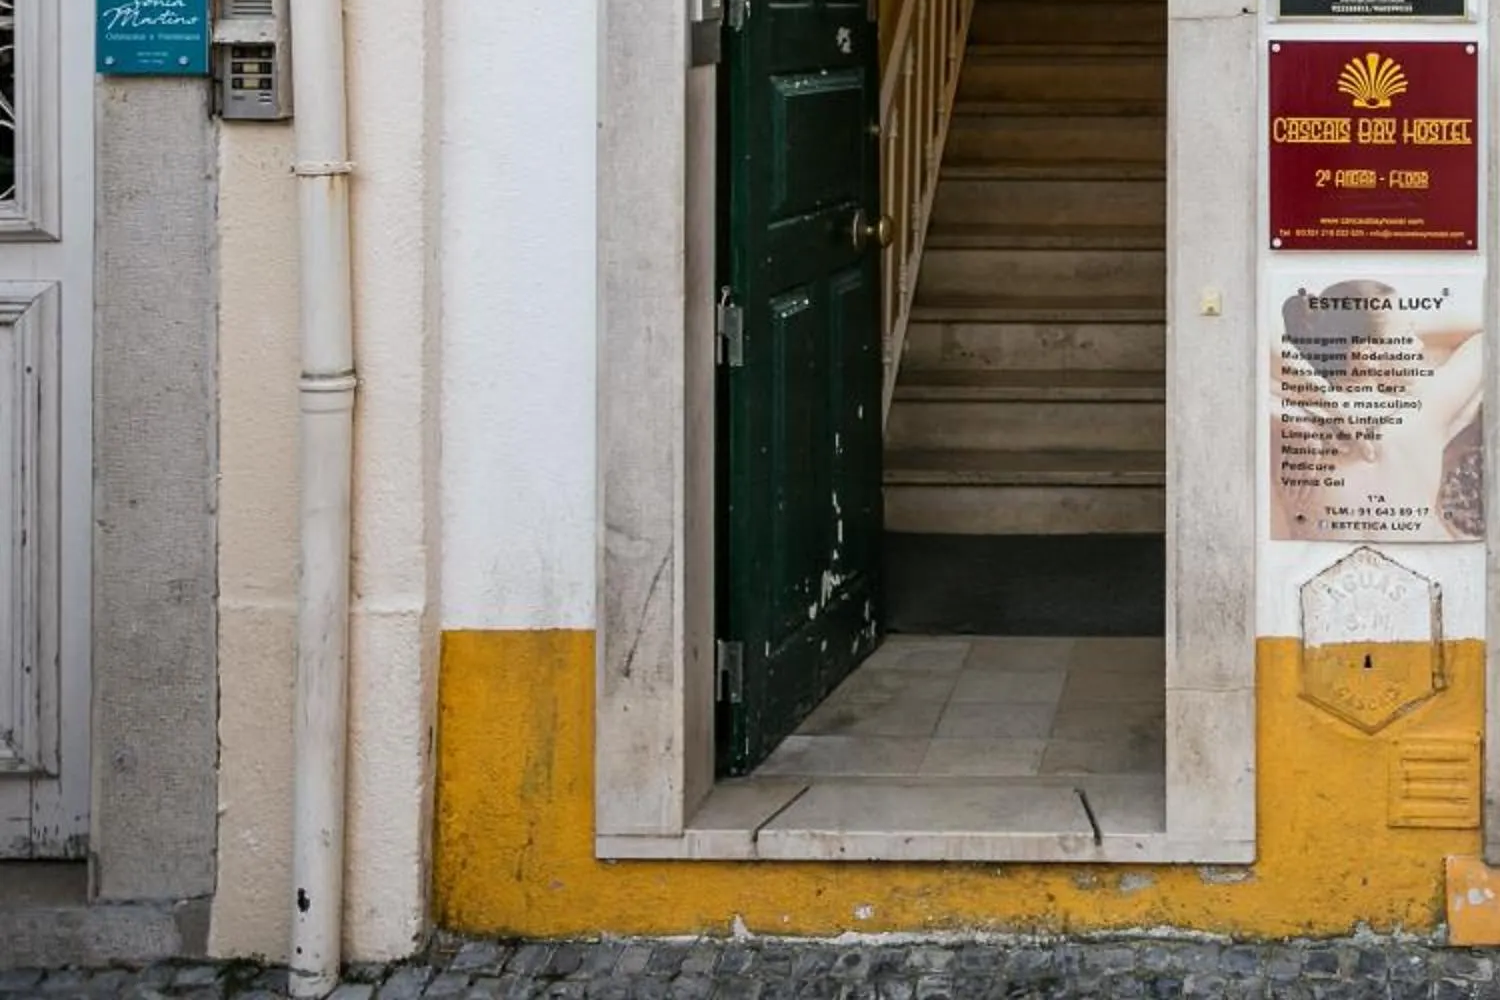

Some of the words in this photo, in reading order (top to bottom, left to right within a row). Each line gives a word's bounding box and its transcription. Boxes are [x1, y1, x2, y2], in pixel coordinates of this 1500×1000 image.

[1357, 117, 1397, 144] BAY
[1403, 118, 1473, 145] HOSTEL
[1399, 298, 1445, 310] LUCY
[1281, 336, 1347, 347] Massagem
[1351, 336, 1414, 345] Relaxante
[1281, 351, 1347, 362] Massagem
[1351, 351, 1424, 361] Modeladora
[1281, 367, 1347, 378] Massagem
[1347, 384, 1373, 393] com
[1377, 383, 1406, 392] Cera
[1353, 399, 1423, 411] masculino)
[1281, 446, 1339, 455] Manicure
[1281, 462, 1336, 471] Pedicure
[1324, 477, 1345, 487] Gel
[1391, 521, 1423, 531] LUCY
